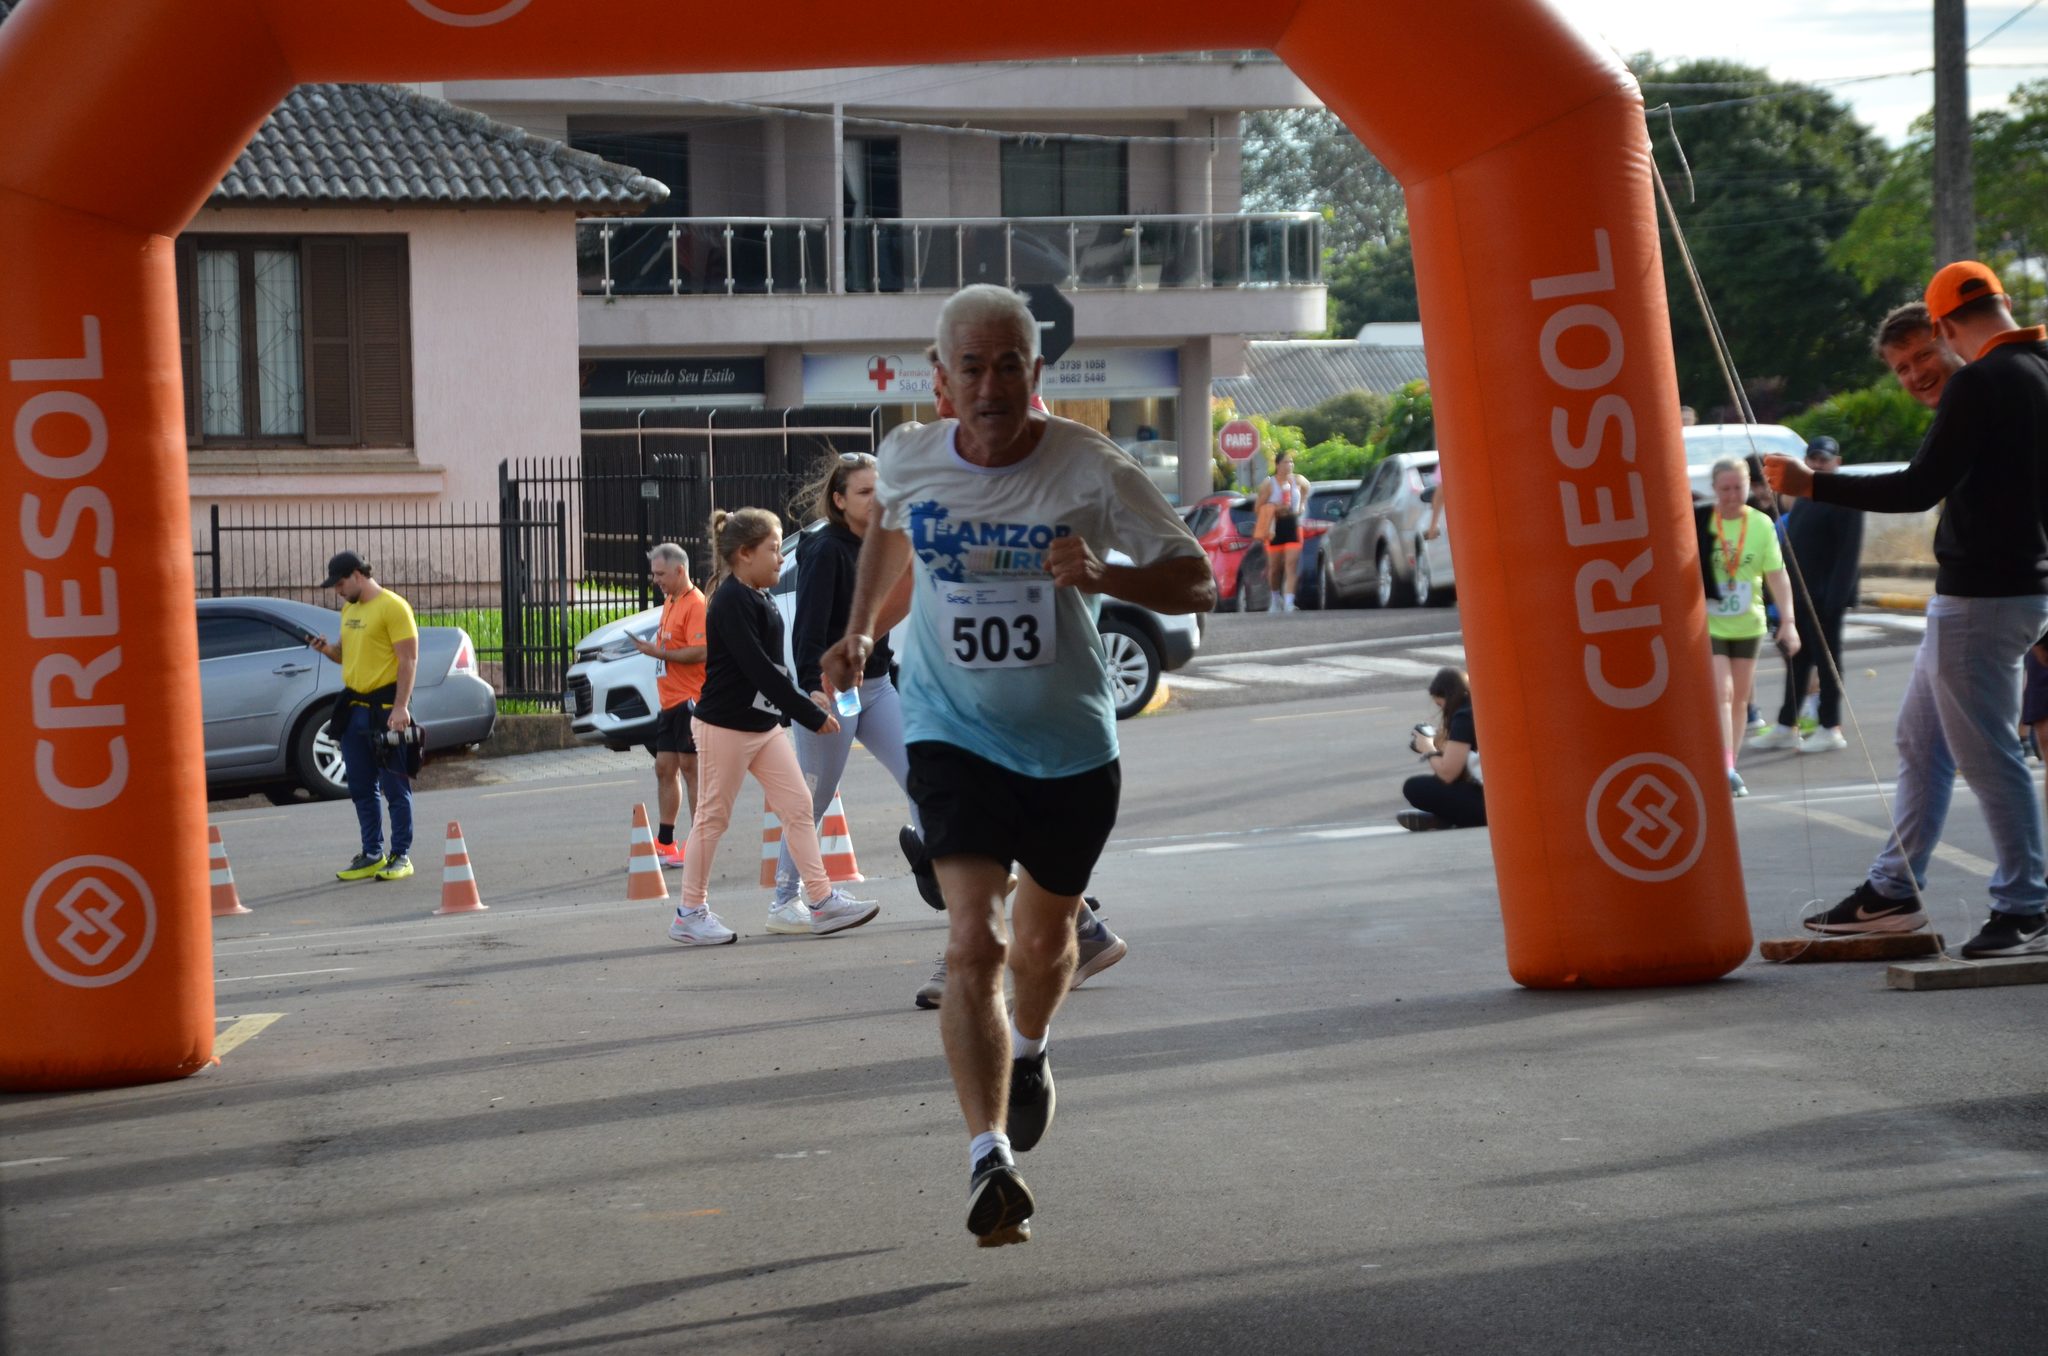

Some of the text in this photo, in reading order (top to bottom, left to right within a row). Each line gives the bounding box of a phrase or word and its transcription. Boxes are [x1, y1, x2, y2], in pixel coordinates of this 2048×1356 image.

[1060, 359, 1081, 370] 3739
[1085, 359, 1106, 369] 1058
[626, 368, 735, 385] Vestindo Seu Estilo
[899, 378, 918, 391] São
[1226, 432, 1252, 448] PARE
[1531, 227, 1669, 709] CRESOL
[9, 315, 129, 809] CRESOL
[953, 614, 1041, 663] 503
